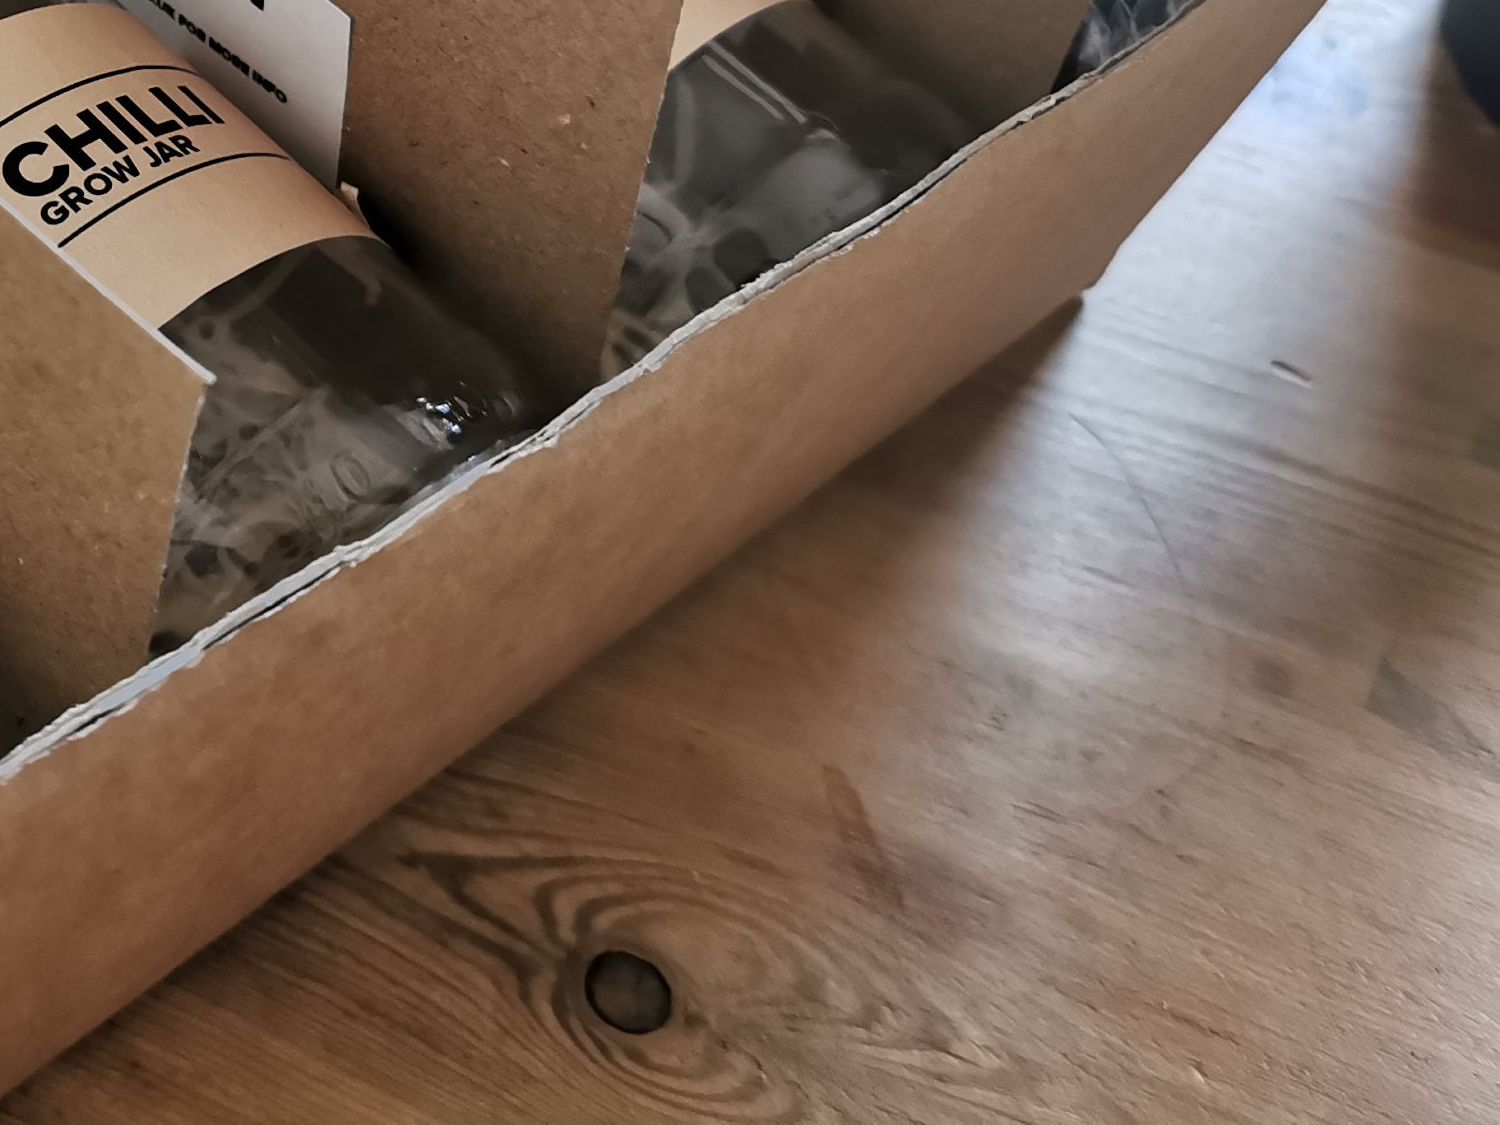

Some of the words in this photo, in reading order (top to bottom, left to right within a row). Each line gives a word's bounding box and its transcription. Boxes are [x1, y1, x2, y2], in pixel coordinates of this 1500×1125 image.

[178, 14, 206, 43] FOR
[208, 37, 250, 77] MORE
[252, 70, 288, 103] INFO
[2, 85, 226, 197] CHILLI
[40, 154, 140, 226] GROW
[142, 134, 201, 168] JAR
